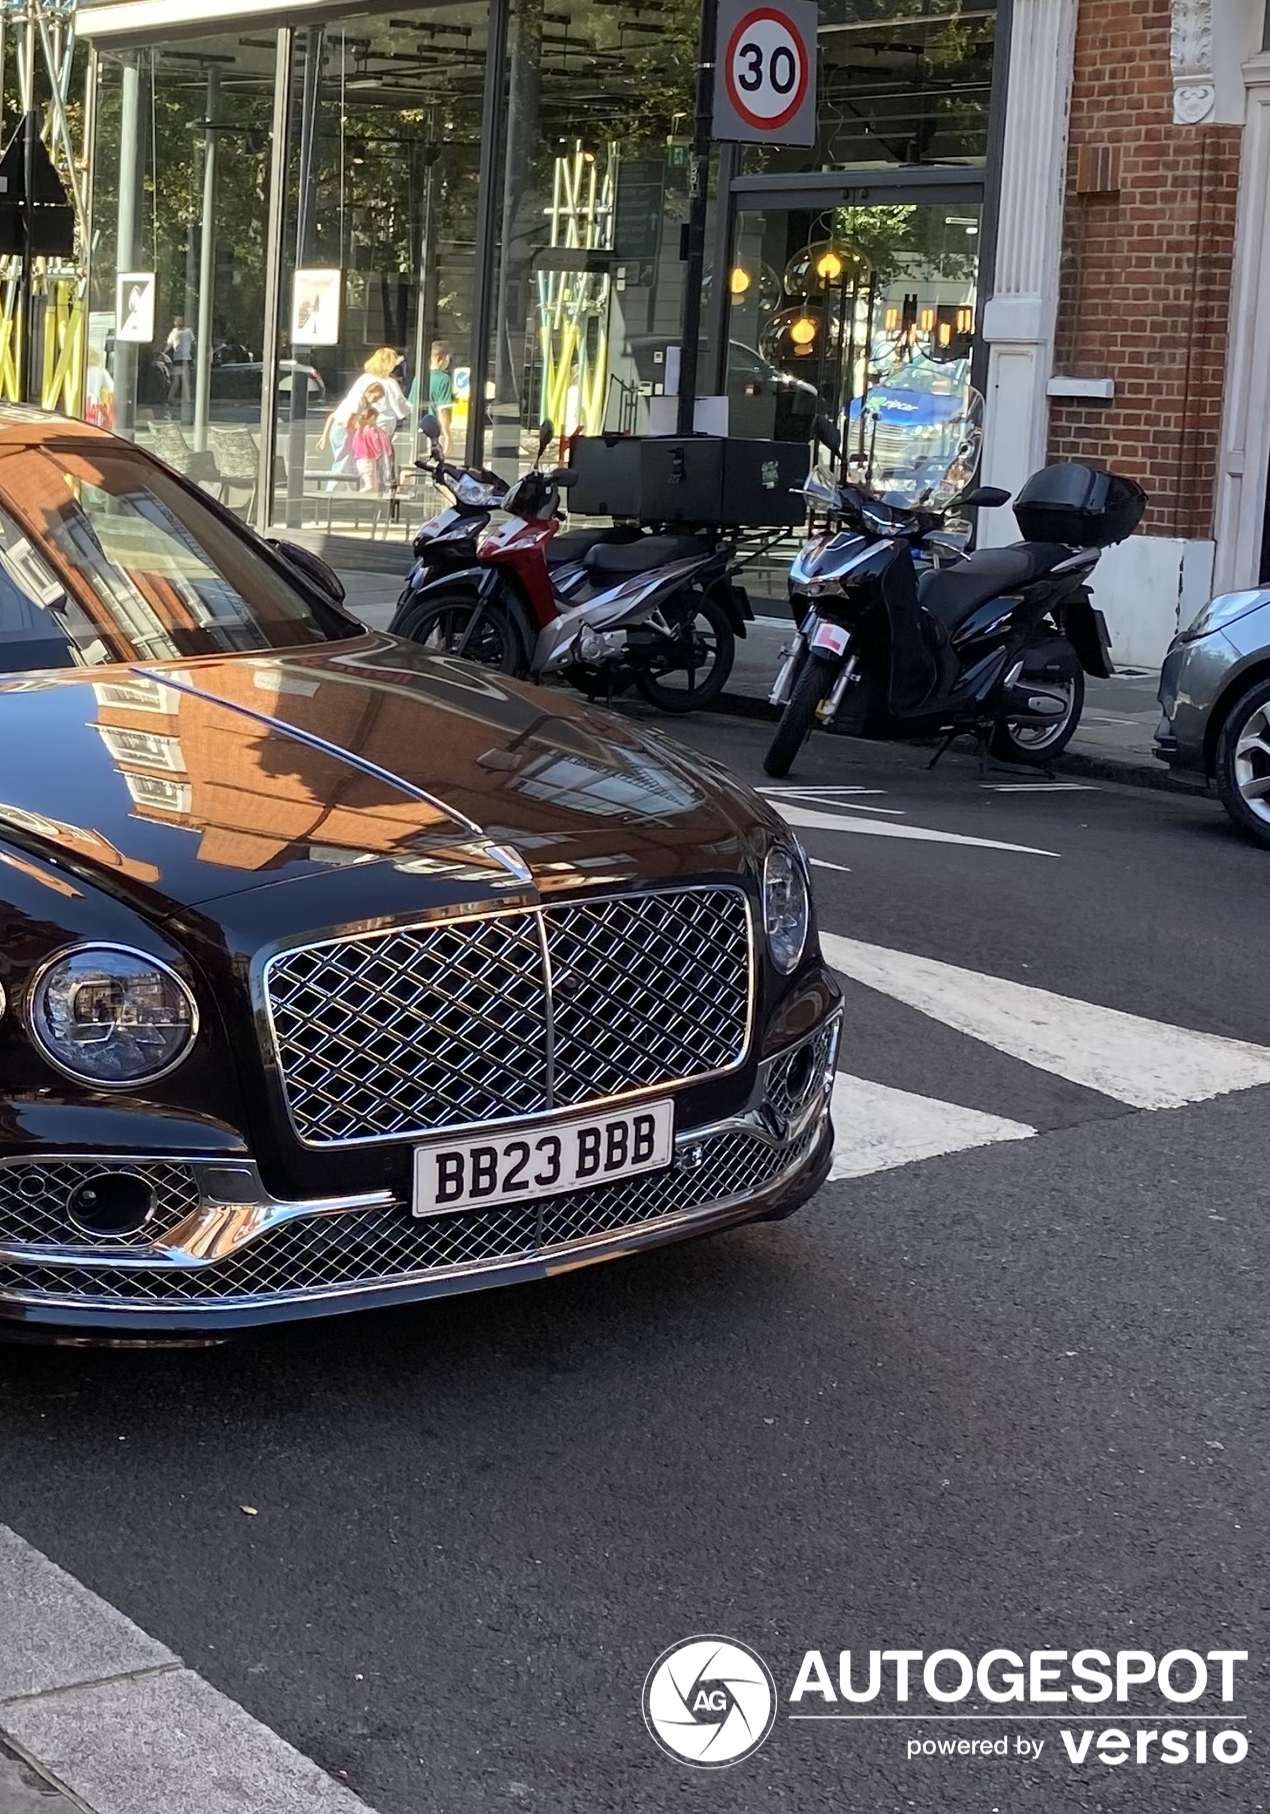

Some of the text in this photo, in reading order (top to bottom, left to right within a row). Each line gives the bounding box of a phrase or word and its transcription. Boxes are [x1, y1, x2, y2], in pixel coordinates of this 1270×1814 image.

[738, 43, 796, 95] 30
[435, 1114, 656, 1204] BB23 BBB
